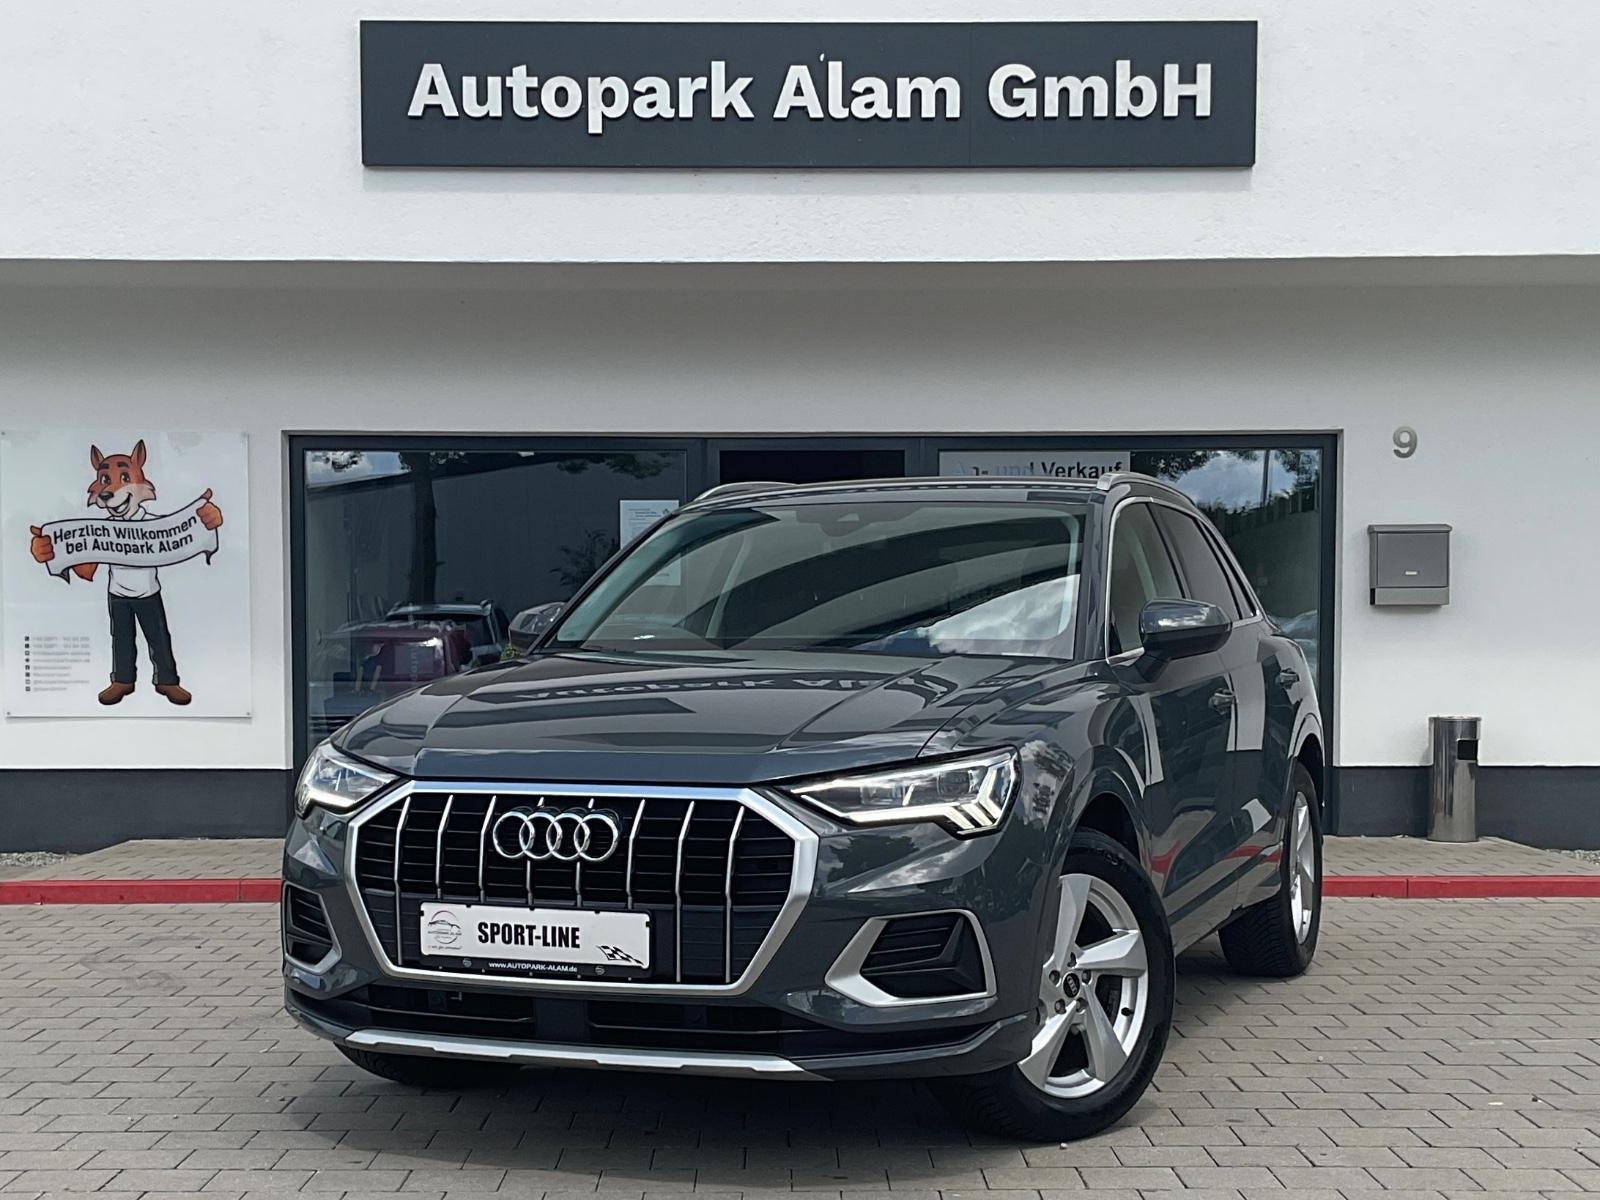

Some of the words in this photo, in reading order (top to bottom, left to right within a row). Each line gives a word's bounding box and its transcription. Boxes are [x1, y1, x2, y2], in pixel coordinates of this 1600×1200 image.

[407, 60, 755, 135] Autopark
[773, 60, 961, 121] Alam
[987, 59, 1213, 120] GmbH
[1392, 426, 1418, 459] 9
[53, 524, 111, 545] Herzlich
[113, 515, 197, 541] Willkommen
[65, 539, 88, 555] bei
[92, 538, 155, 556] Autopark
[158, 533, 193, 553] Alam
[477, 921, 581, 949] SPORT-LINE
[488, 962, 578, 973] www.AUTOPARK-ALAM.de
